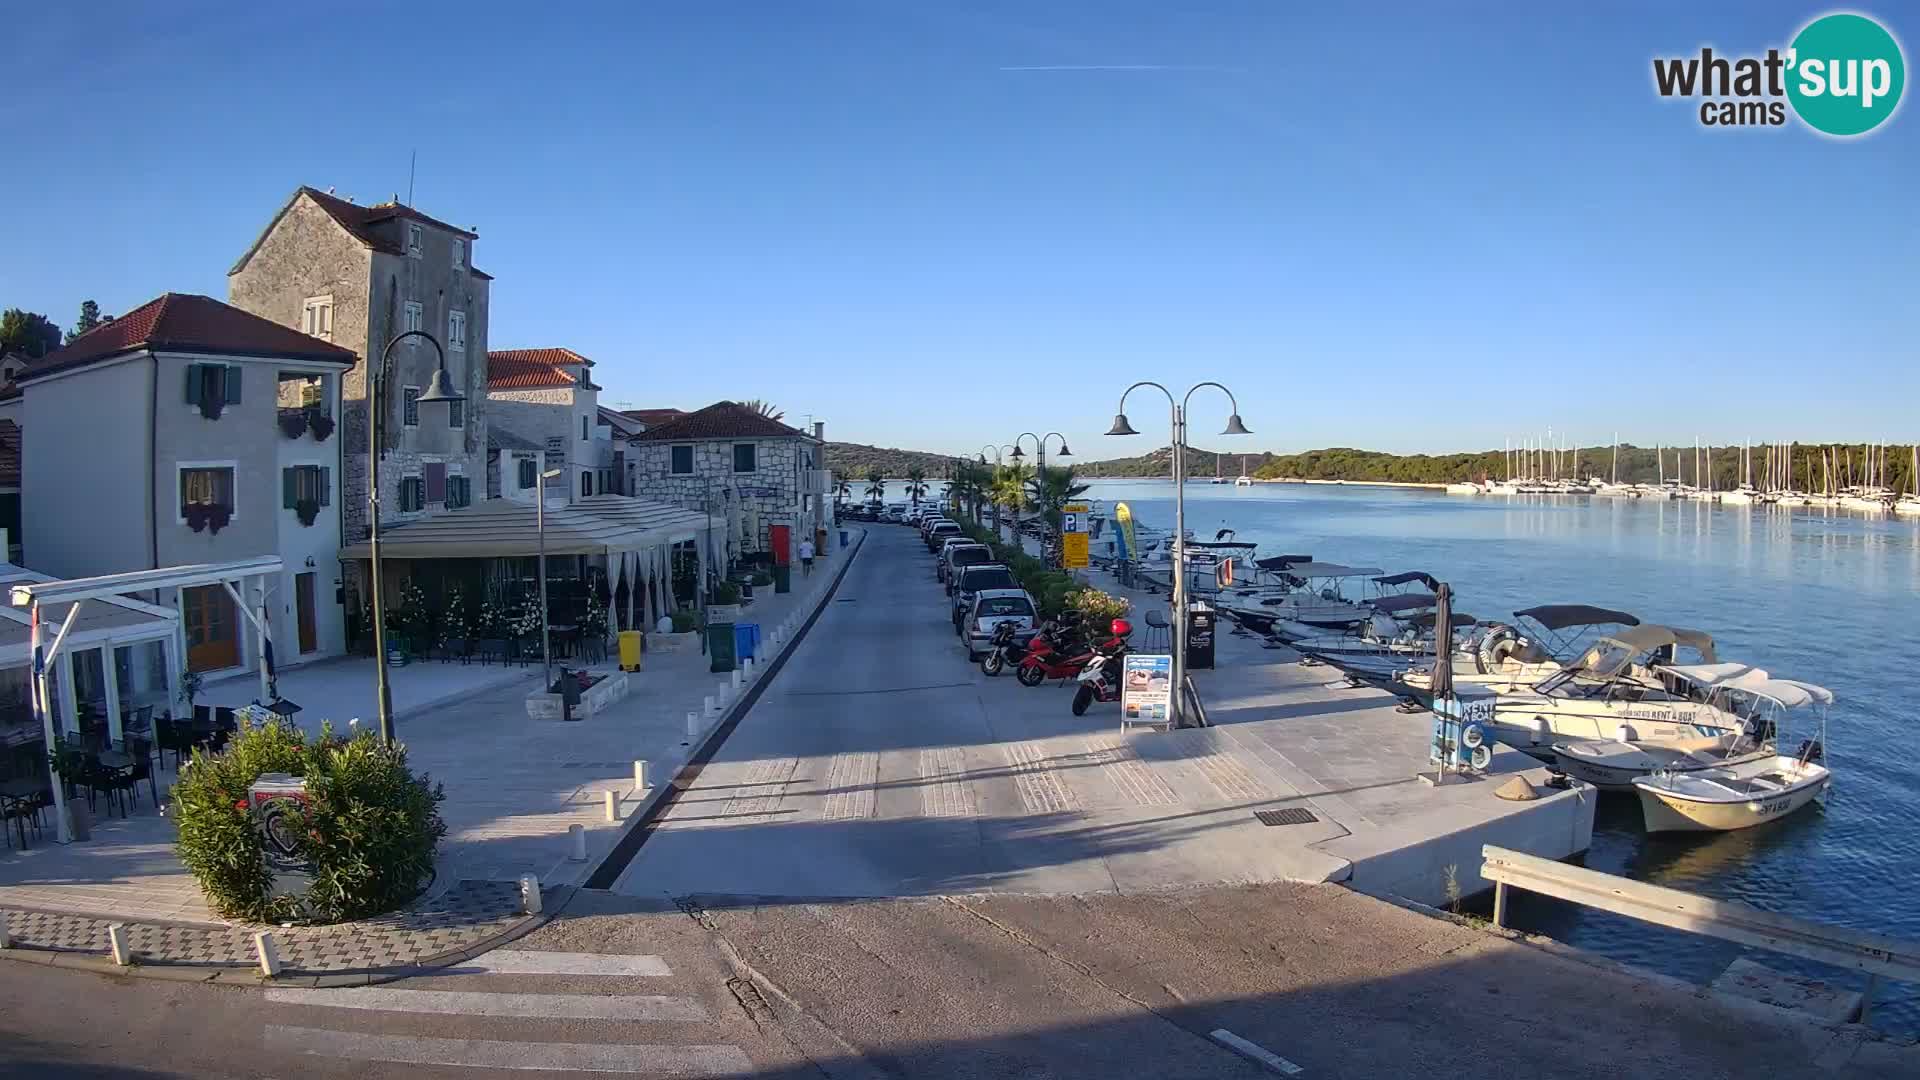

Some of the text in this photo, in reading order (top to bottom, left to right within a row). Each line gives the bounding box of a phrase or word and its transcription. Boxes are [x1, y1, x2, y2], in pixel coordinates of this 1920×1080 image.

[1463, 703, 1495, 713] RENT
[1463, 711, 1494, 721] A BOAT
[1652, 711, 1671, 720] RENT
